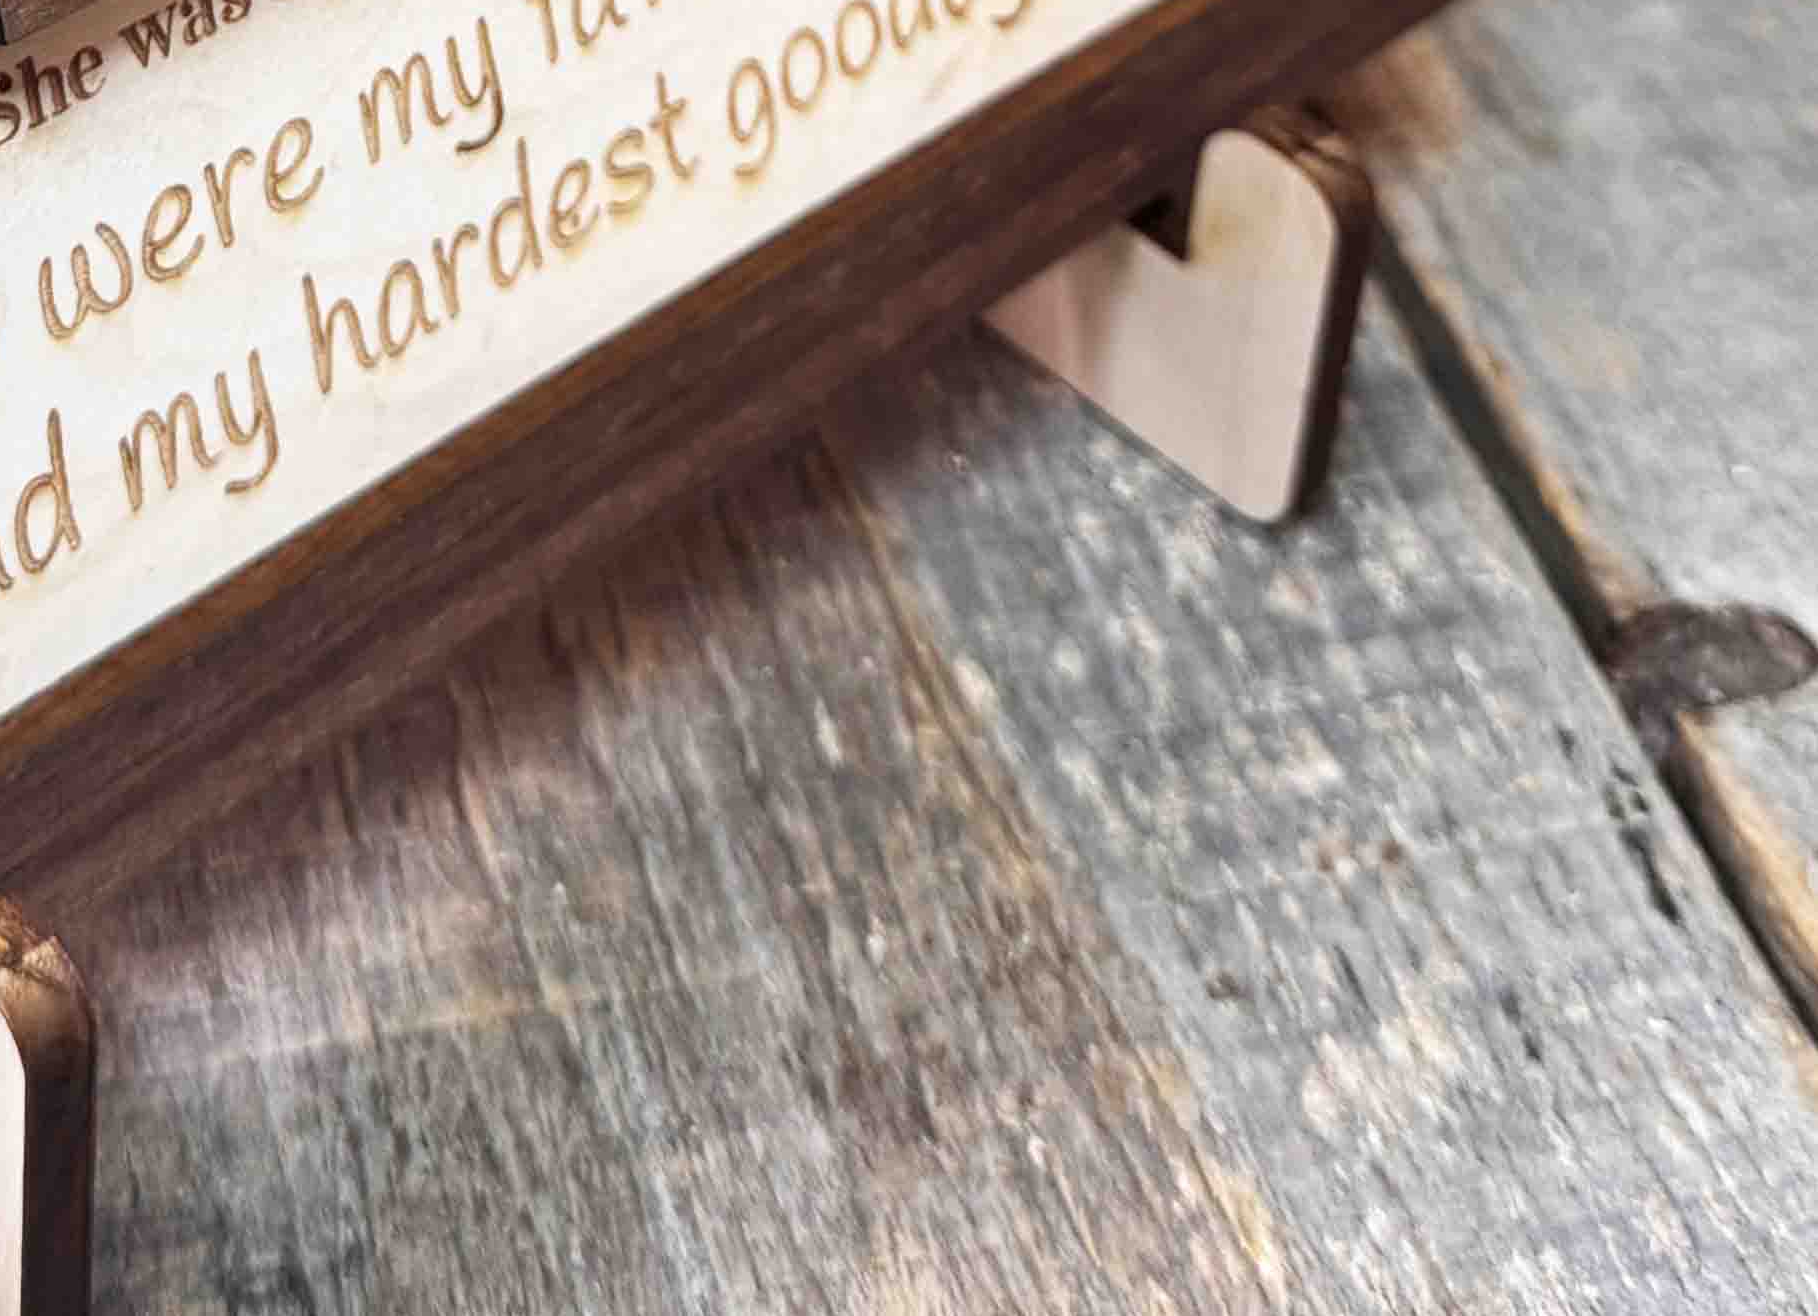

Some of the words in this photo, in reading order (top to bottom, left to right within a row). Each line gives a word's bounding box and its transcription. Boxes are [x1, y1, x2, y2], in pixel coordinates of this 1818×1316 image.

[36, 111, 325, 343] were
[356, 16, 506, 155] my
[117, 348, 282, 515] my
[300, 75, 700, 396] hardest
